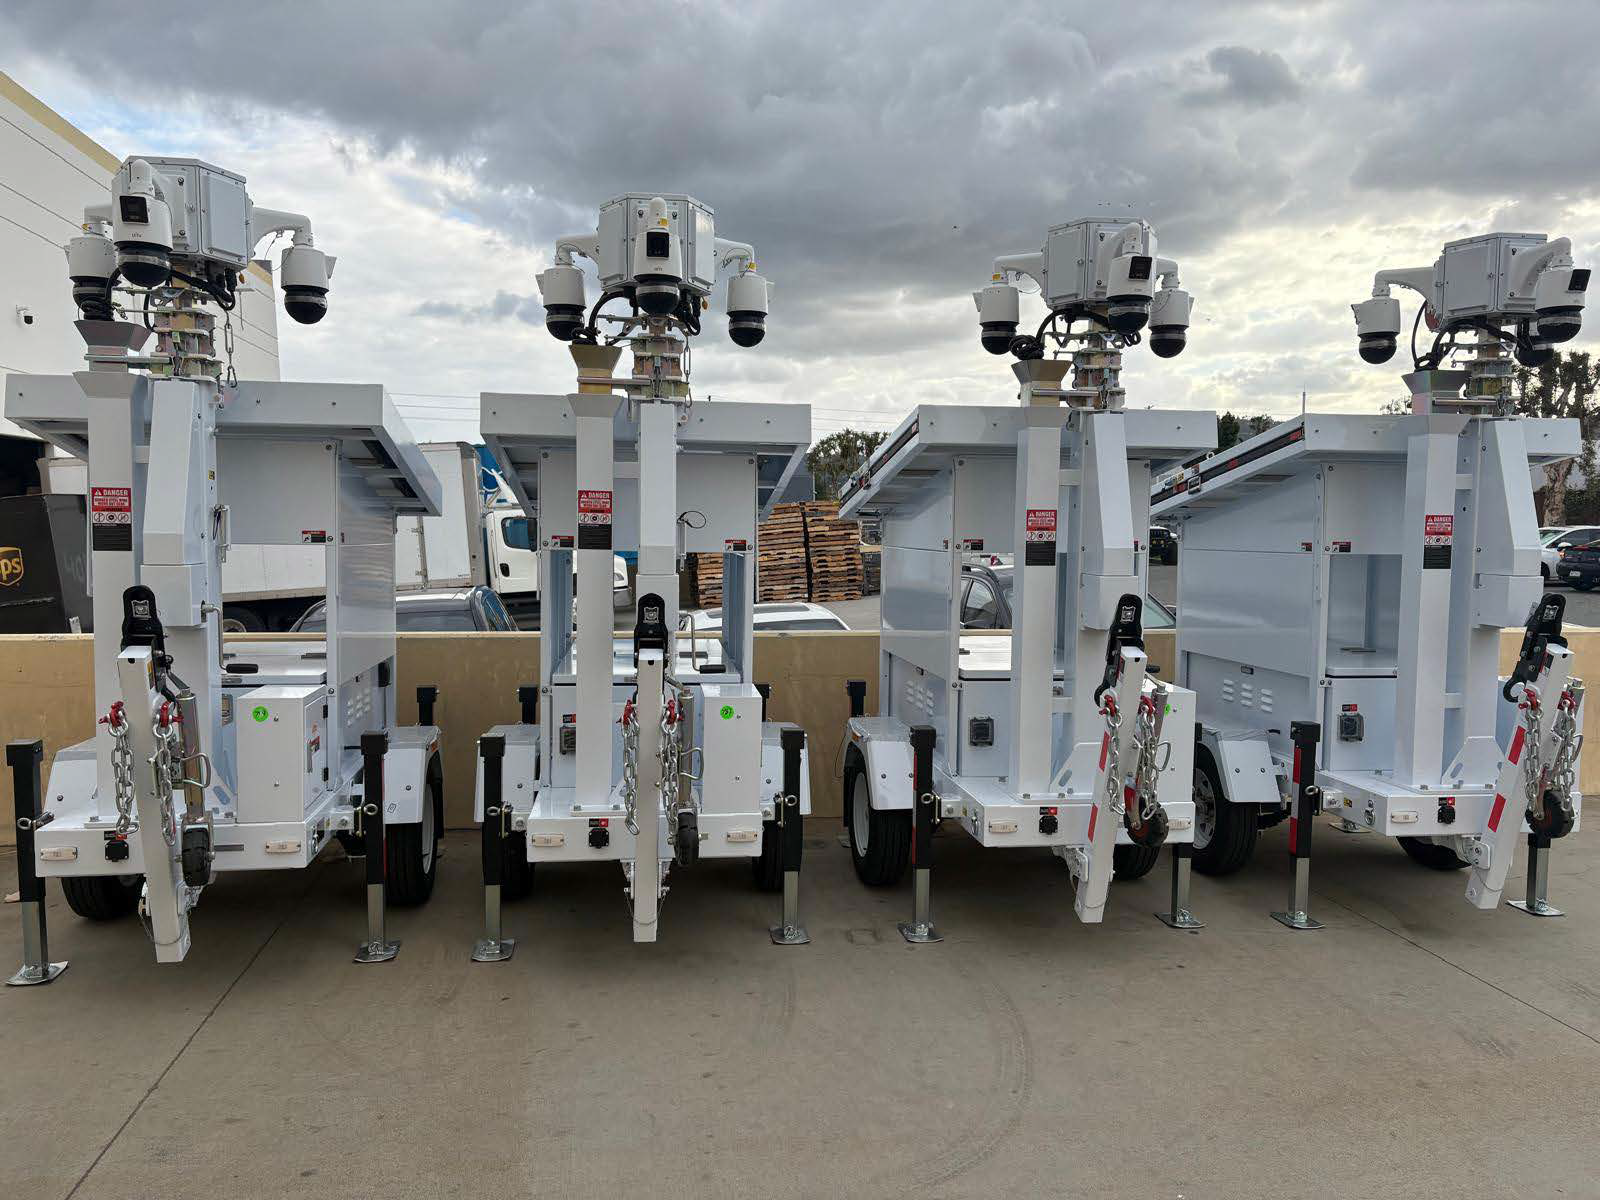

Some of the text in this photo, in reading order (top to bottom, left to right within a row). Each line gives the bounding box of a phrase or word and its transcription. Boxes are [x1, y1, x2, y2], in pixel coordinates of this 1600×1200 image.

[103, 489, 129, 497] DANGER
[588, 491, 610, 499] DANGER
[0, 557, 22, 580] ps
